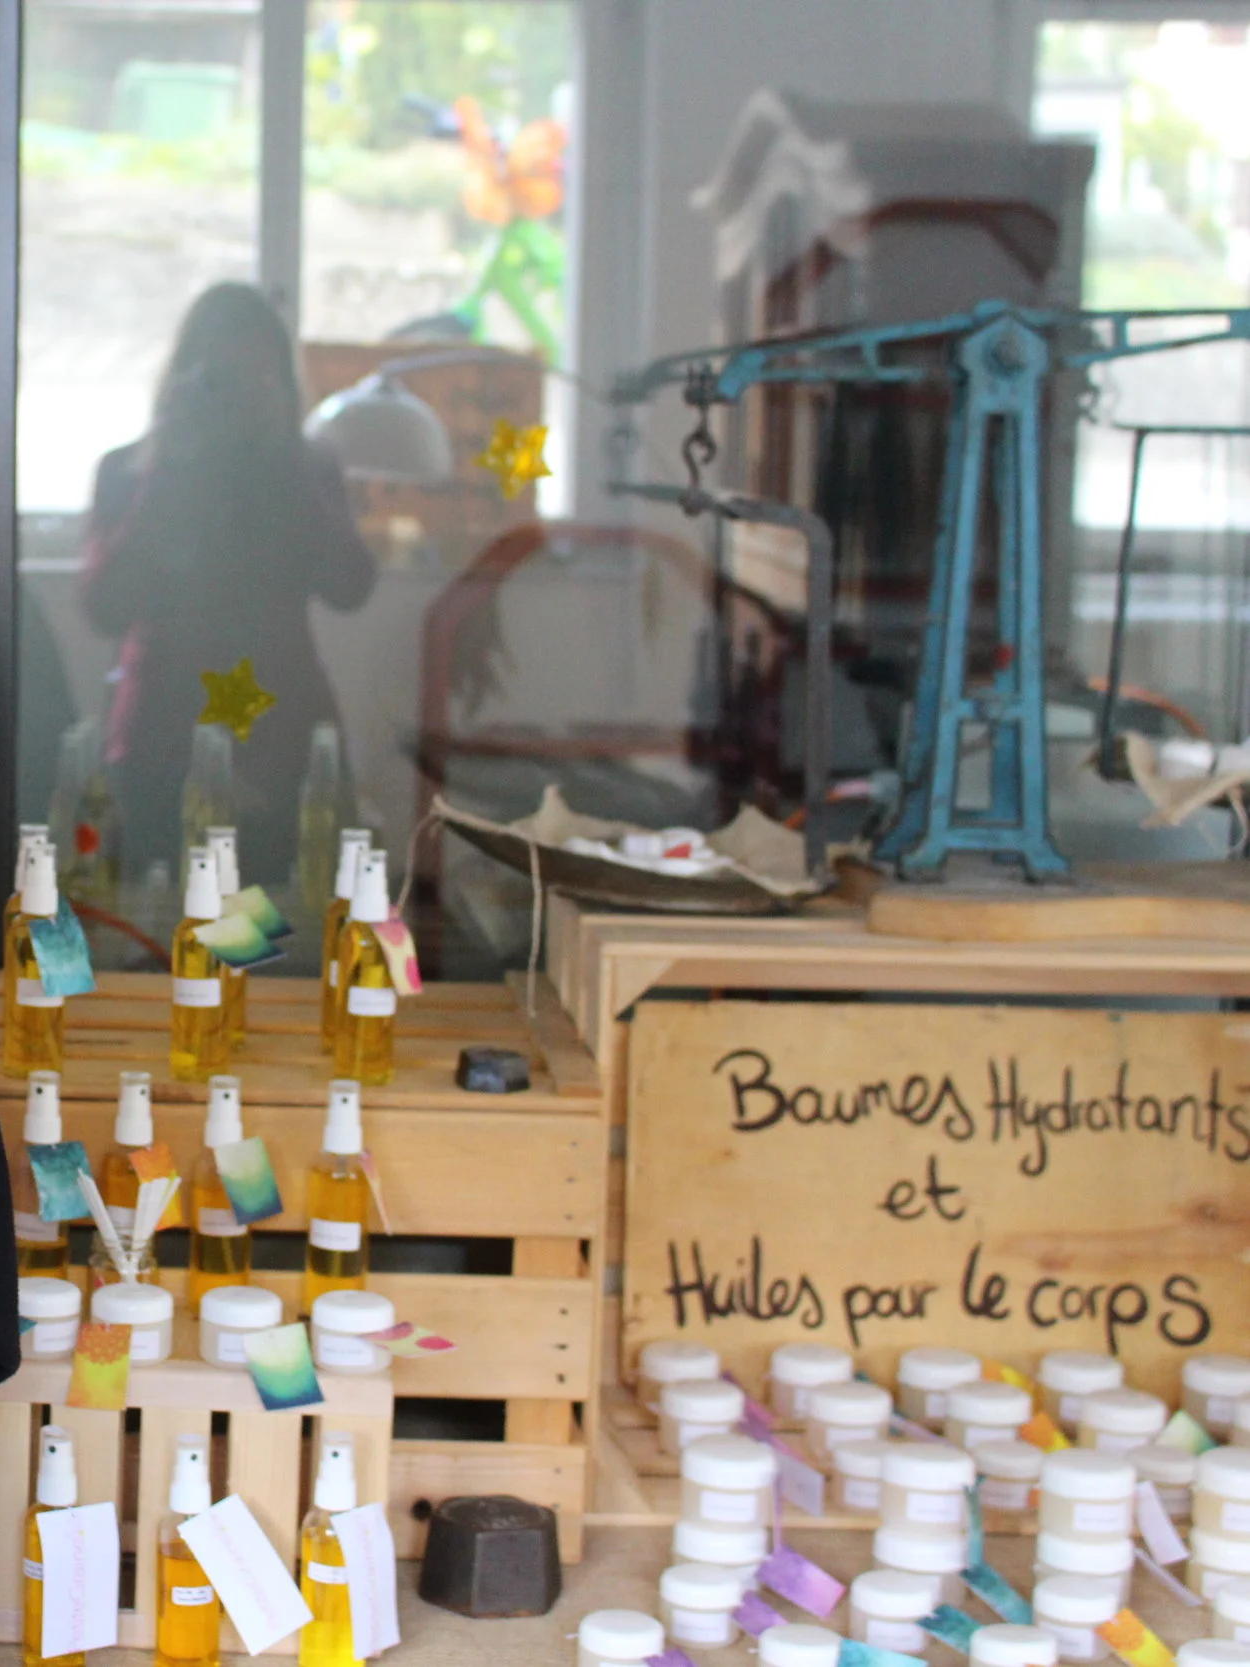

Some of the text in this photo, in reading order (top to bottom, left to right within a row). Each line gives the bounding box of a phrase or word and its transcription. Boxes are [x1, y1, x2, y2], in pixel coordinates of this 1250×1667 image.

[712, 1047, 1250, 1177] Baumes Hydratants
[876, 1153, 967, 1222] et
[665, 1234, 1212, 1358] Huiles pour le corps
